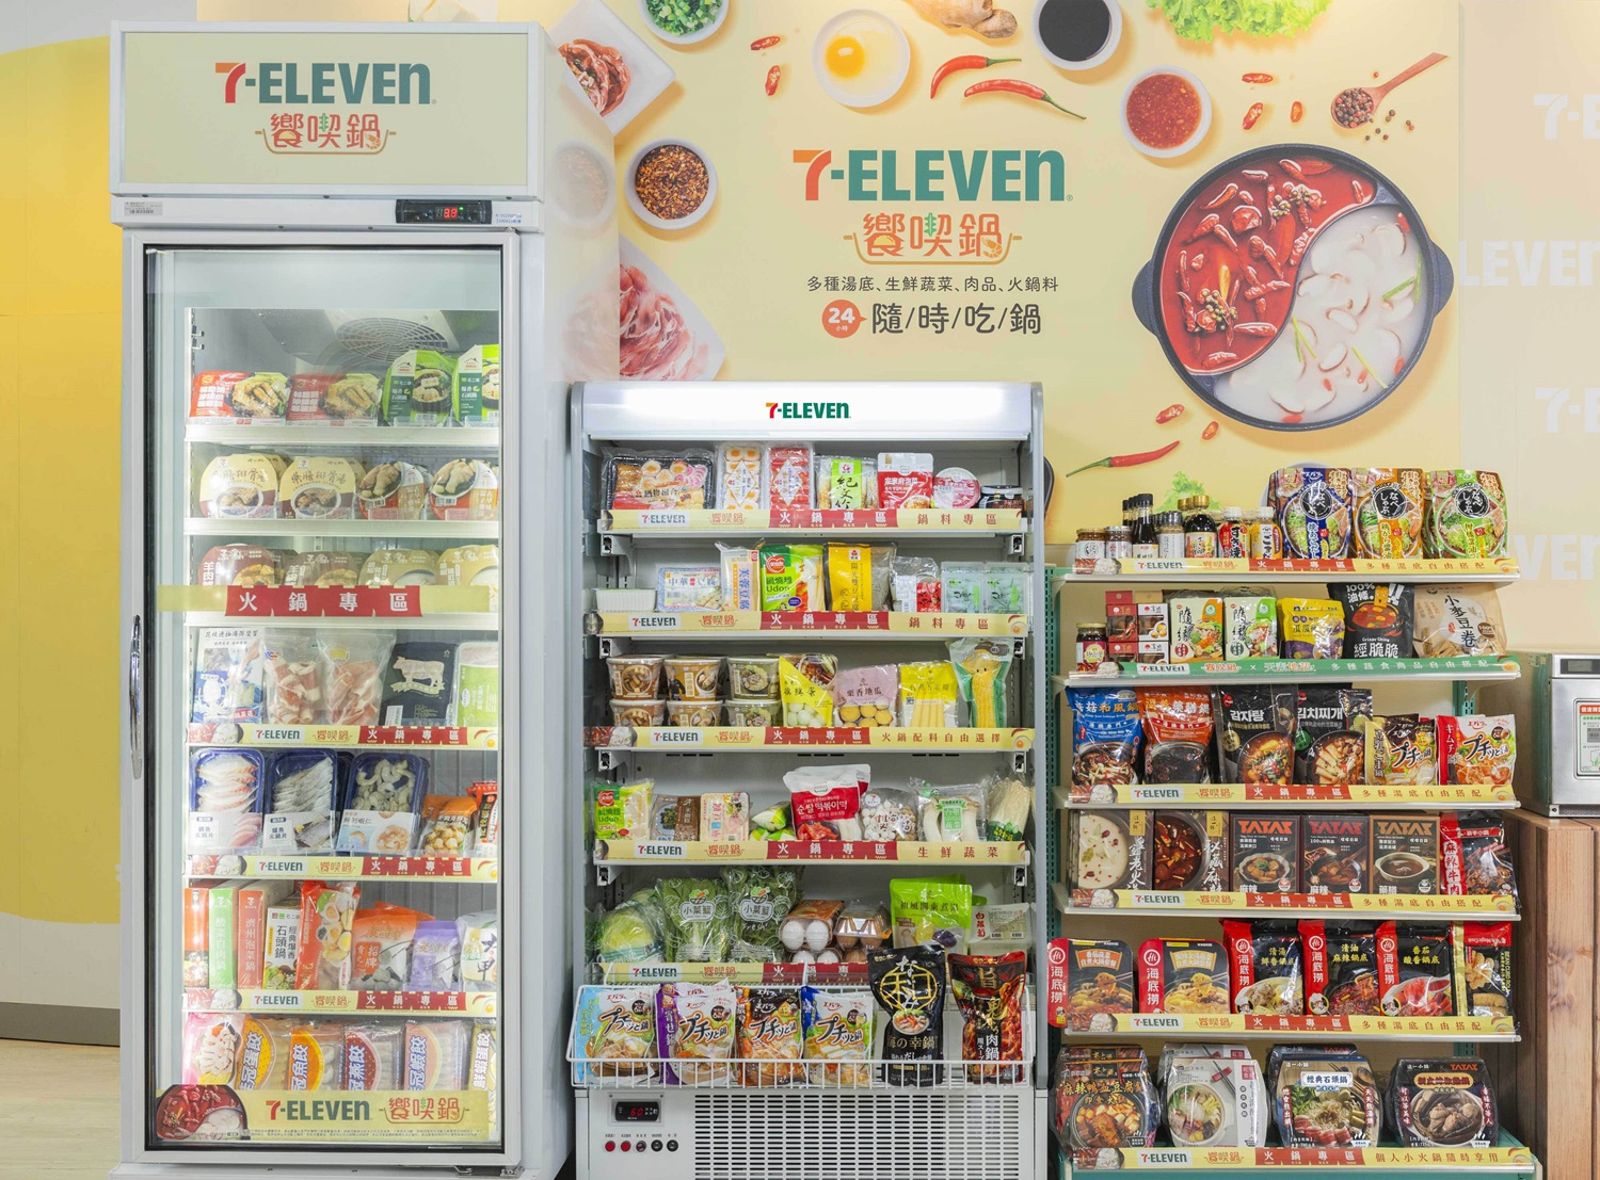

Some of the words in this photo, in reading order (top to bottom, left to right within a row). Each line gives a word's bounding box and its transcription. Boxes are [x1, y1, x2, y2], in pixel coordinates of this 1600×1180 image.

[863, 212, 1001, 258] 饗喫鍋
[828, 307, 855, 324] 24
[872, 303, 1040, 335] 隨/時/吃/鍋
[238, 592, 408, 613] 火鍋專區
[1230, 709, 1265, 722] 감자탕
[1297, 707, 1343, 720] 김치찌개
[918, 847, 998, 858] 生鮮蔬菜
[275, 925, 287, 959] 石頭鍋
[1146, 968, 1159, 1005] 海底撈
